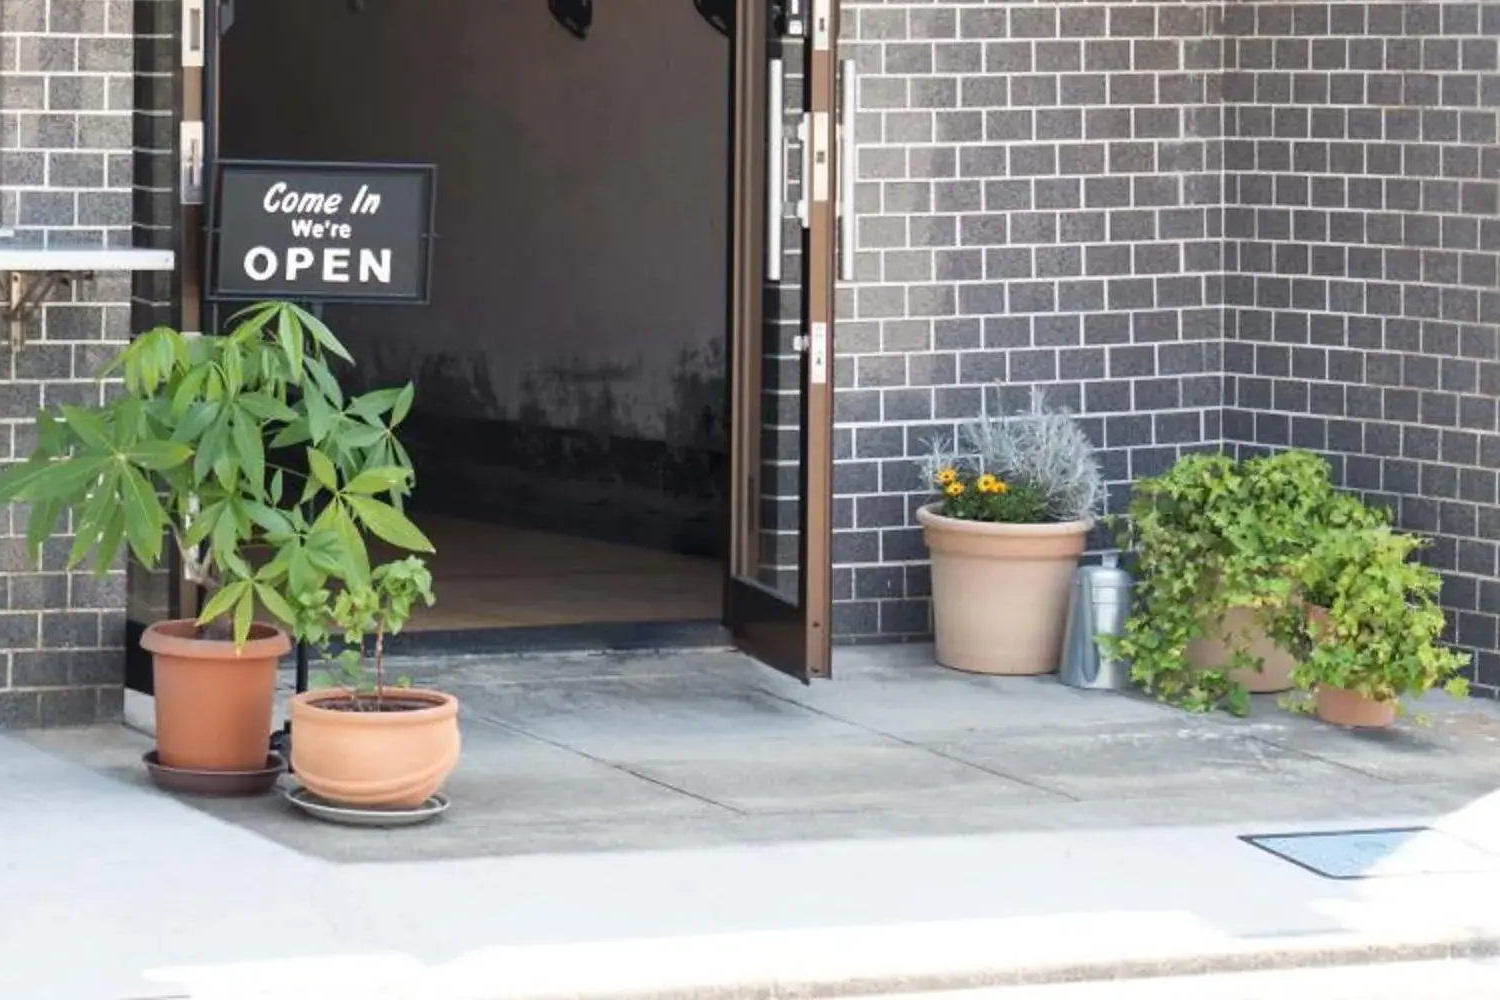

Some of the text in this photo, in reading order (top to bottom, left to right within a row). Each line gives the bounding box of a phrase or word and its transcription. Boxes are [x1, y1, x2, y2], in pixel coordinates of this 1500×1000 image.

[263, 181, 381, 215] Come In
[291, 219, 352, 239] We're
[243, 246, 392, 283] OPEN
